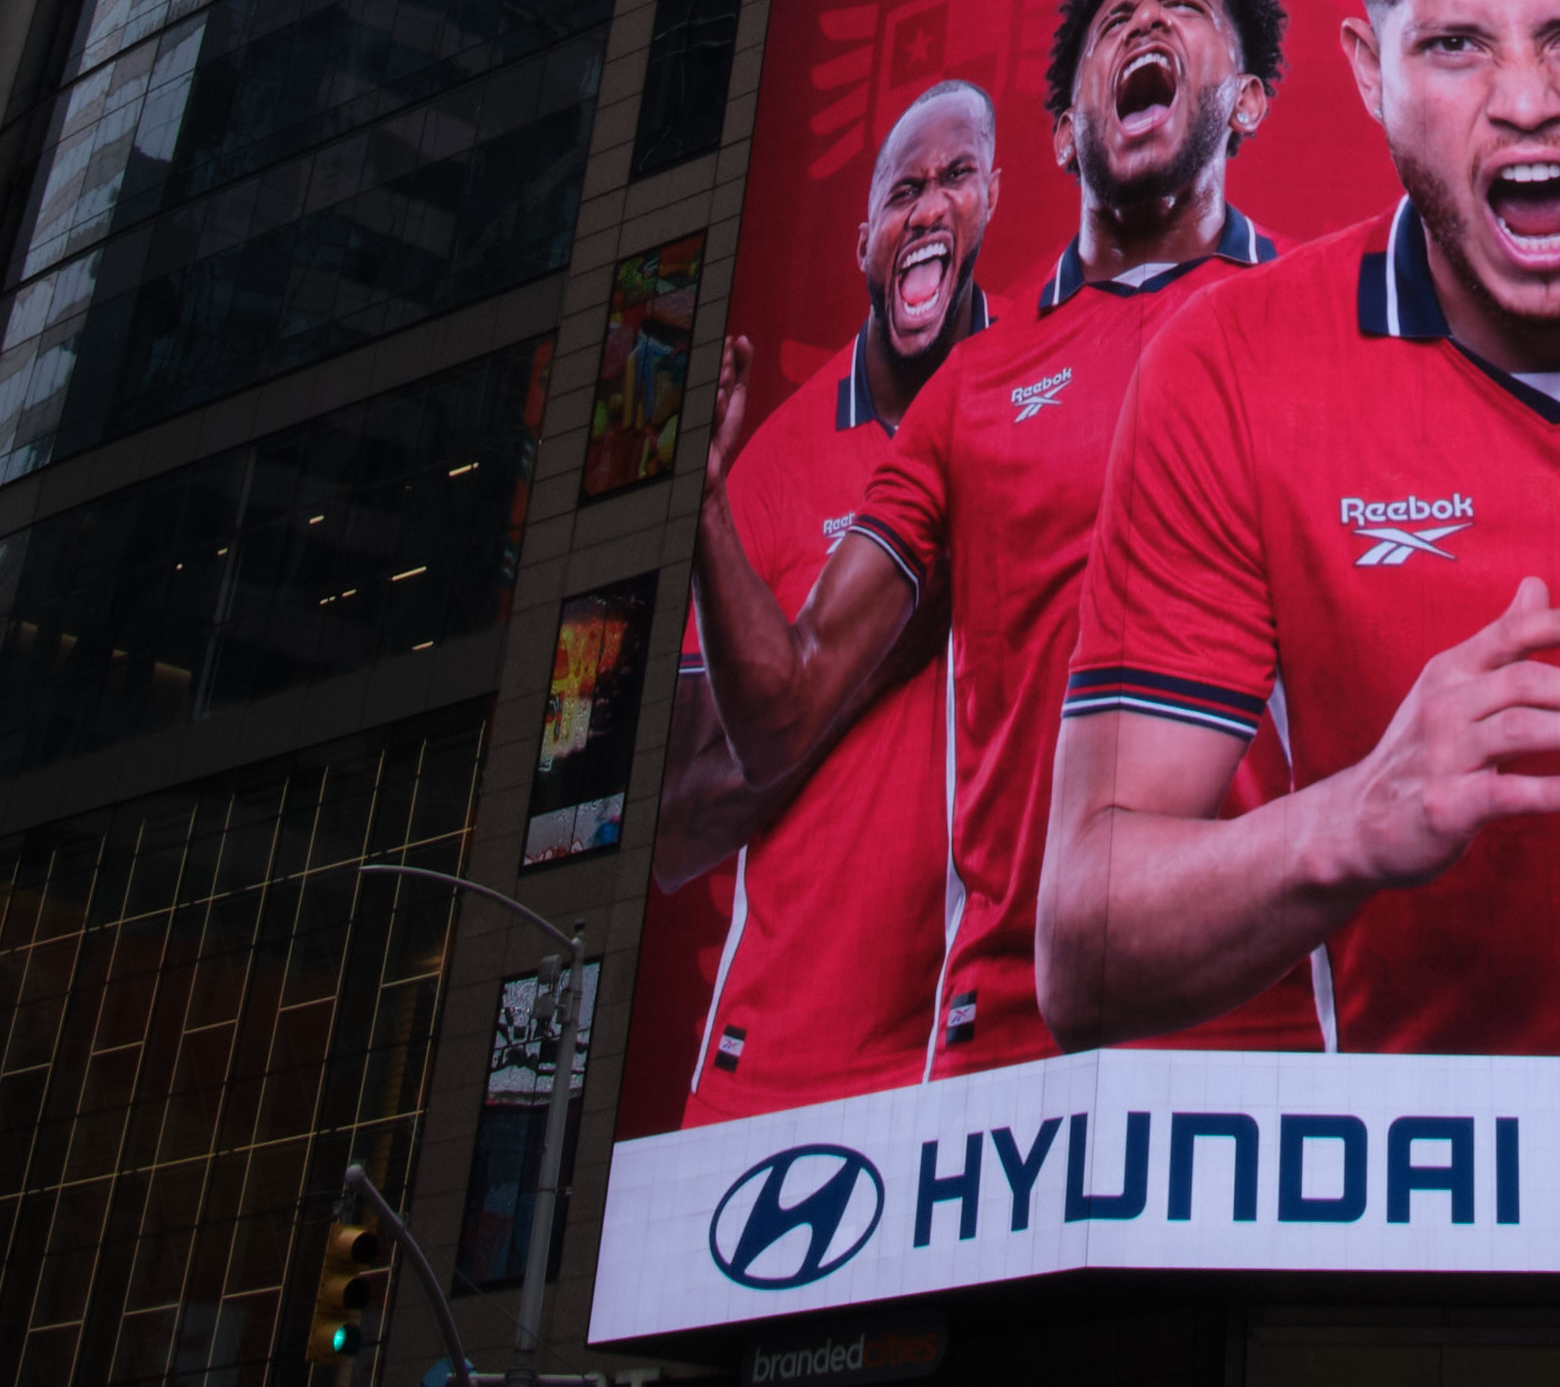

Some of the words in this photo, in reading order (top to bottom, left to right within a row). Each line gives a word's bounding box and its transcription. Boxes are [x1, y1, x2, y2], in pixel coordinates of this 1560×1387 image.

[1011, 367, 1073, 404] Reebok
[1340, 492, 1474, 527] Reebok
[912, 1110, 1521, 1250] HYUNDAI
